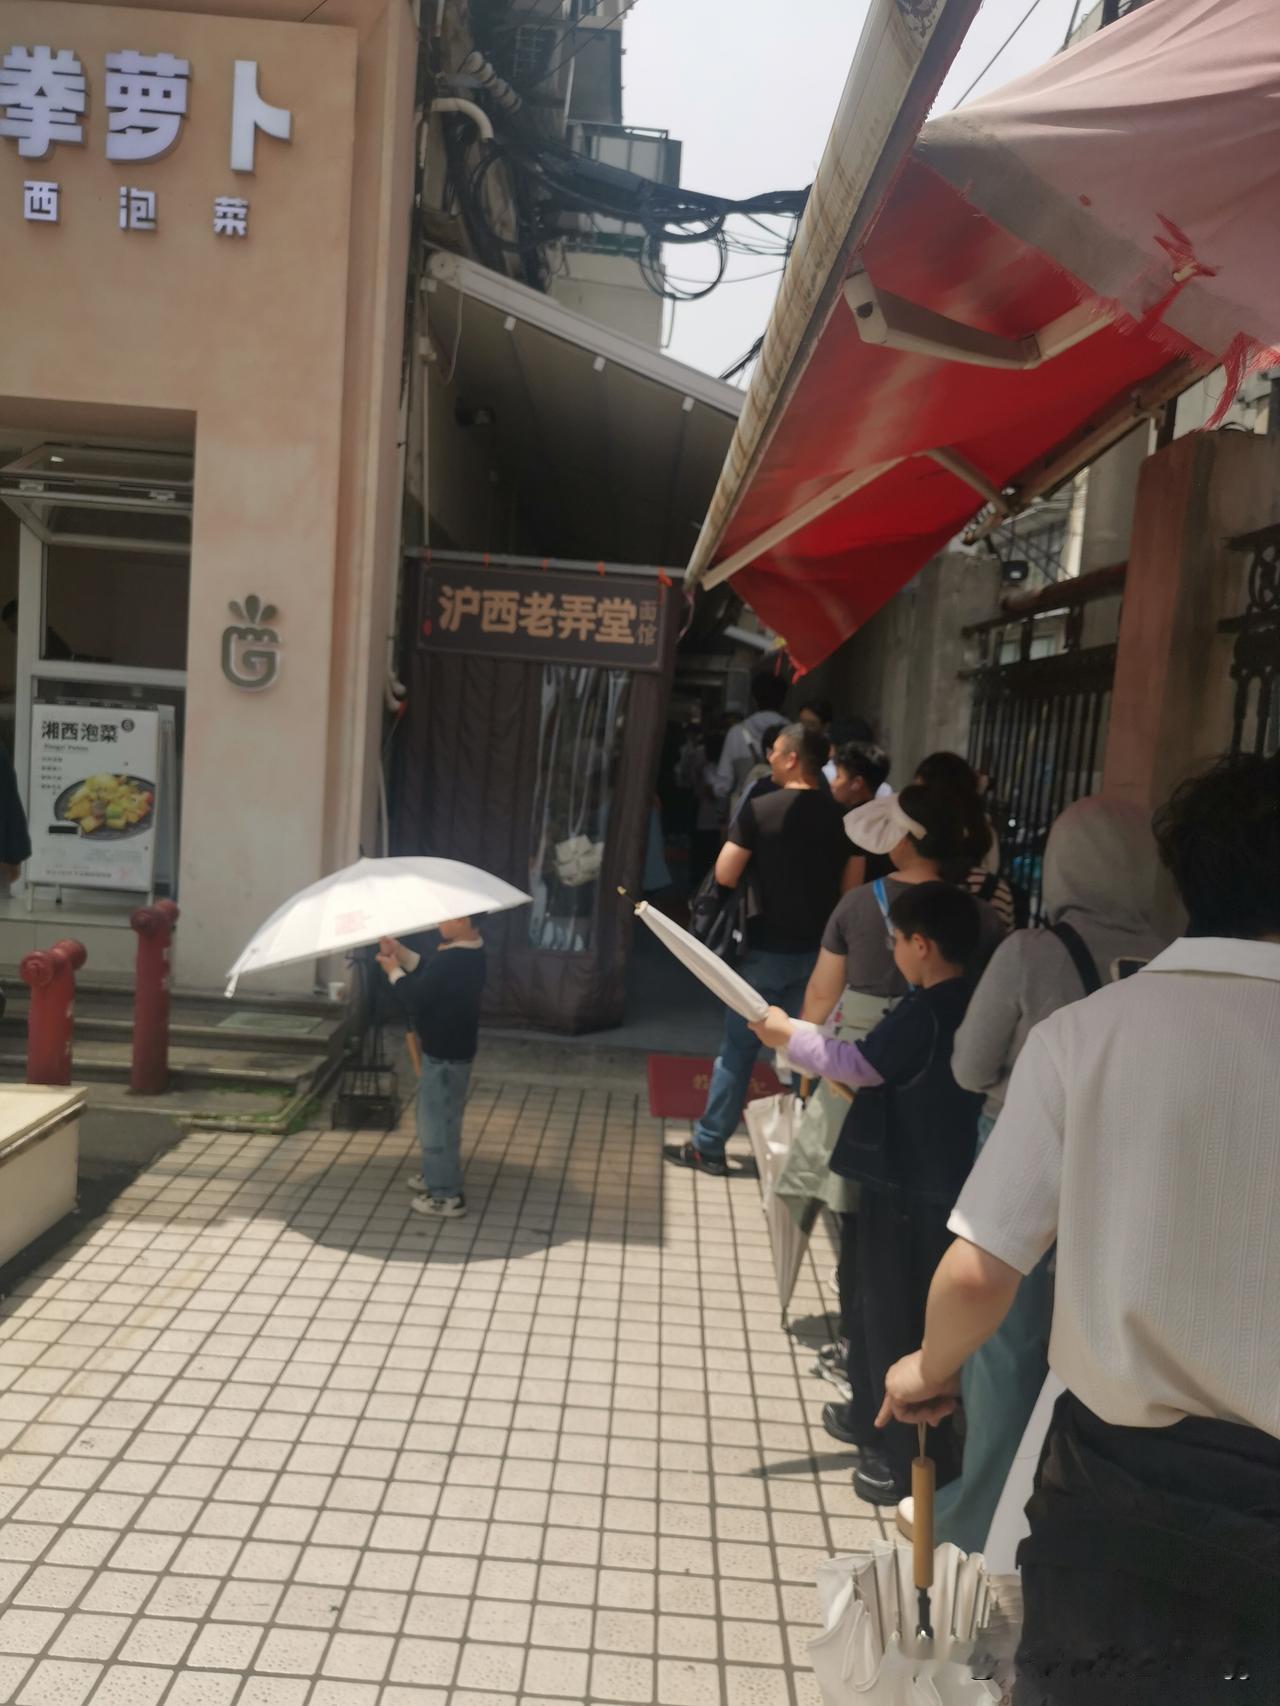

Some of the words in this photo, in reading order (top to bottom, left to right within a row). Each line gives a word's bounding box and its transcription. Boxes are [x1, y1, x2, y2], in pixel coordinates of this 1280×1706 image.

[24, 180, 249, 237] 西泡菜
[438, 585, 636, 645] 沪西老弄堂
[41, 720, 118, 743] 湘西泡菜
